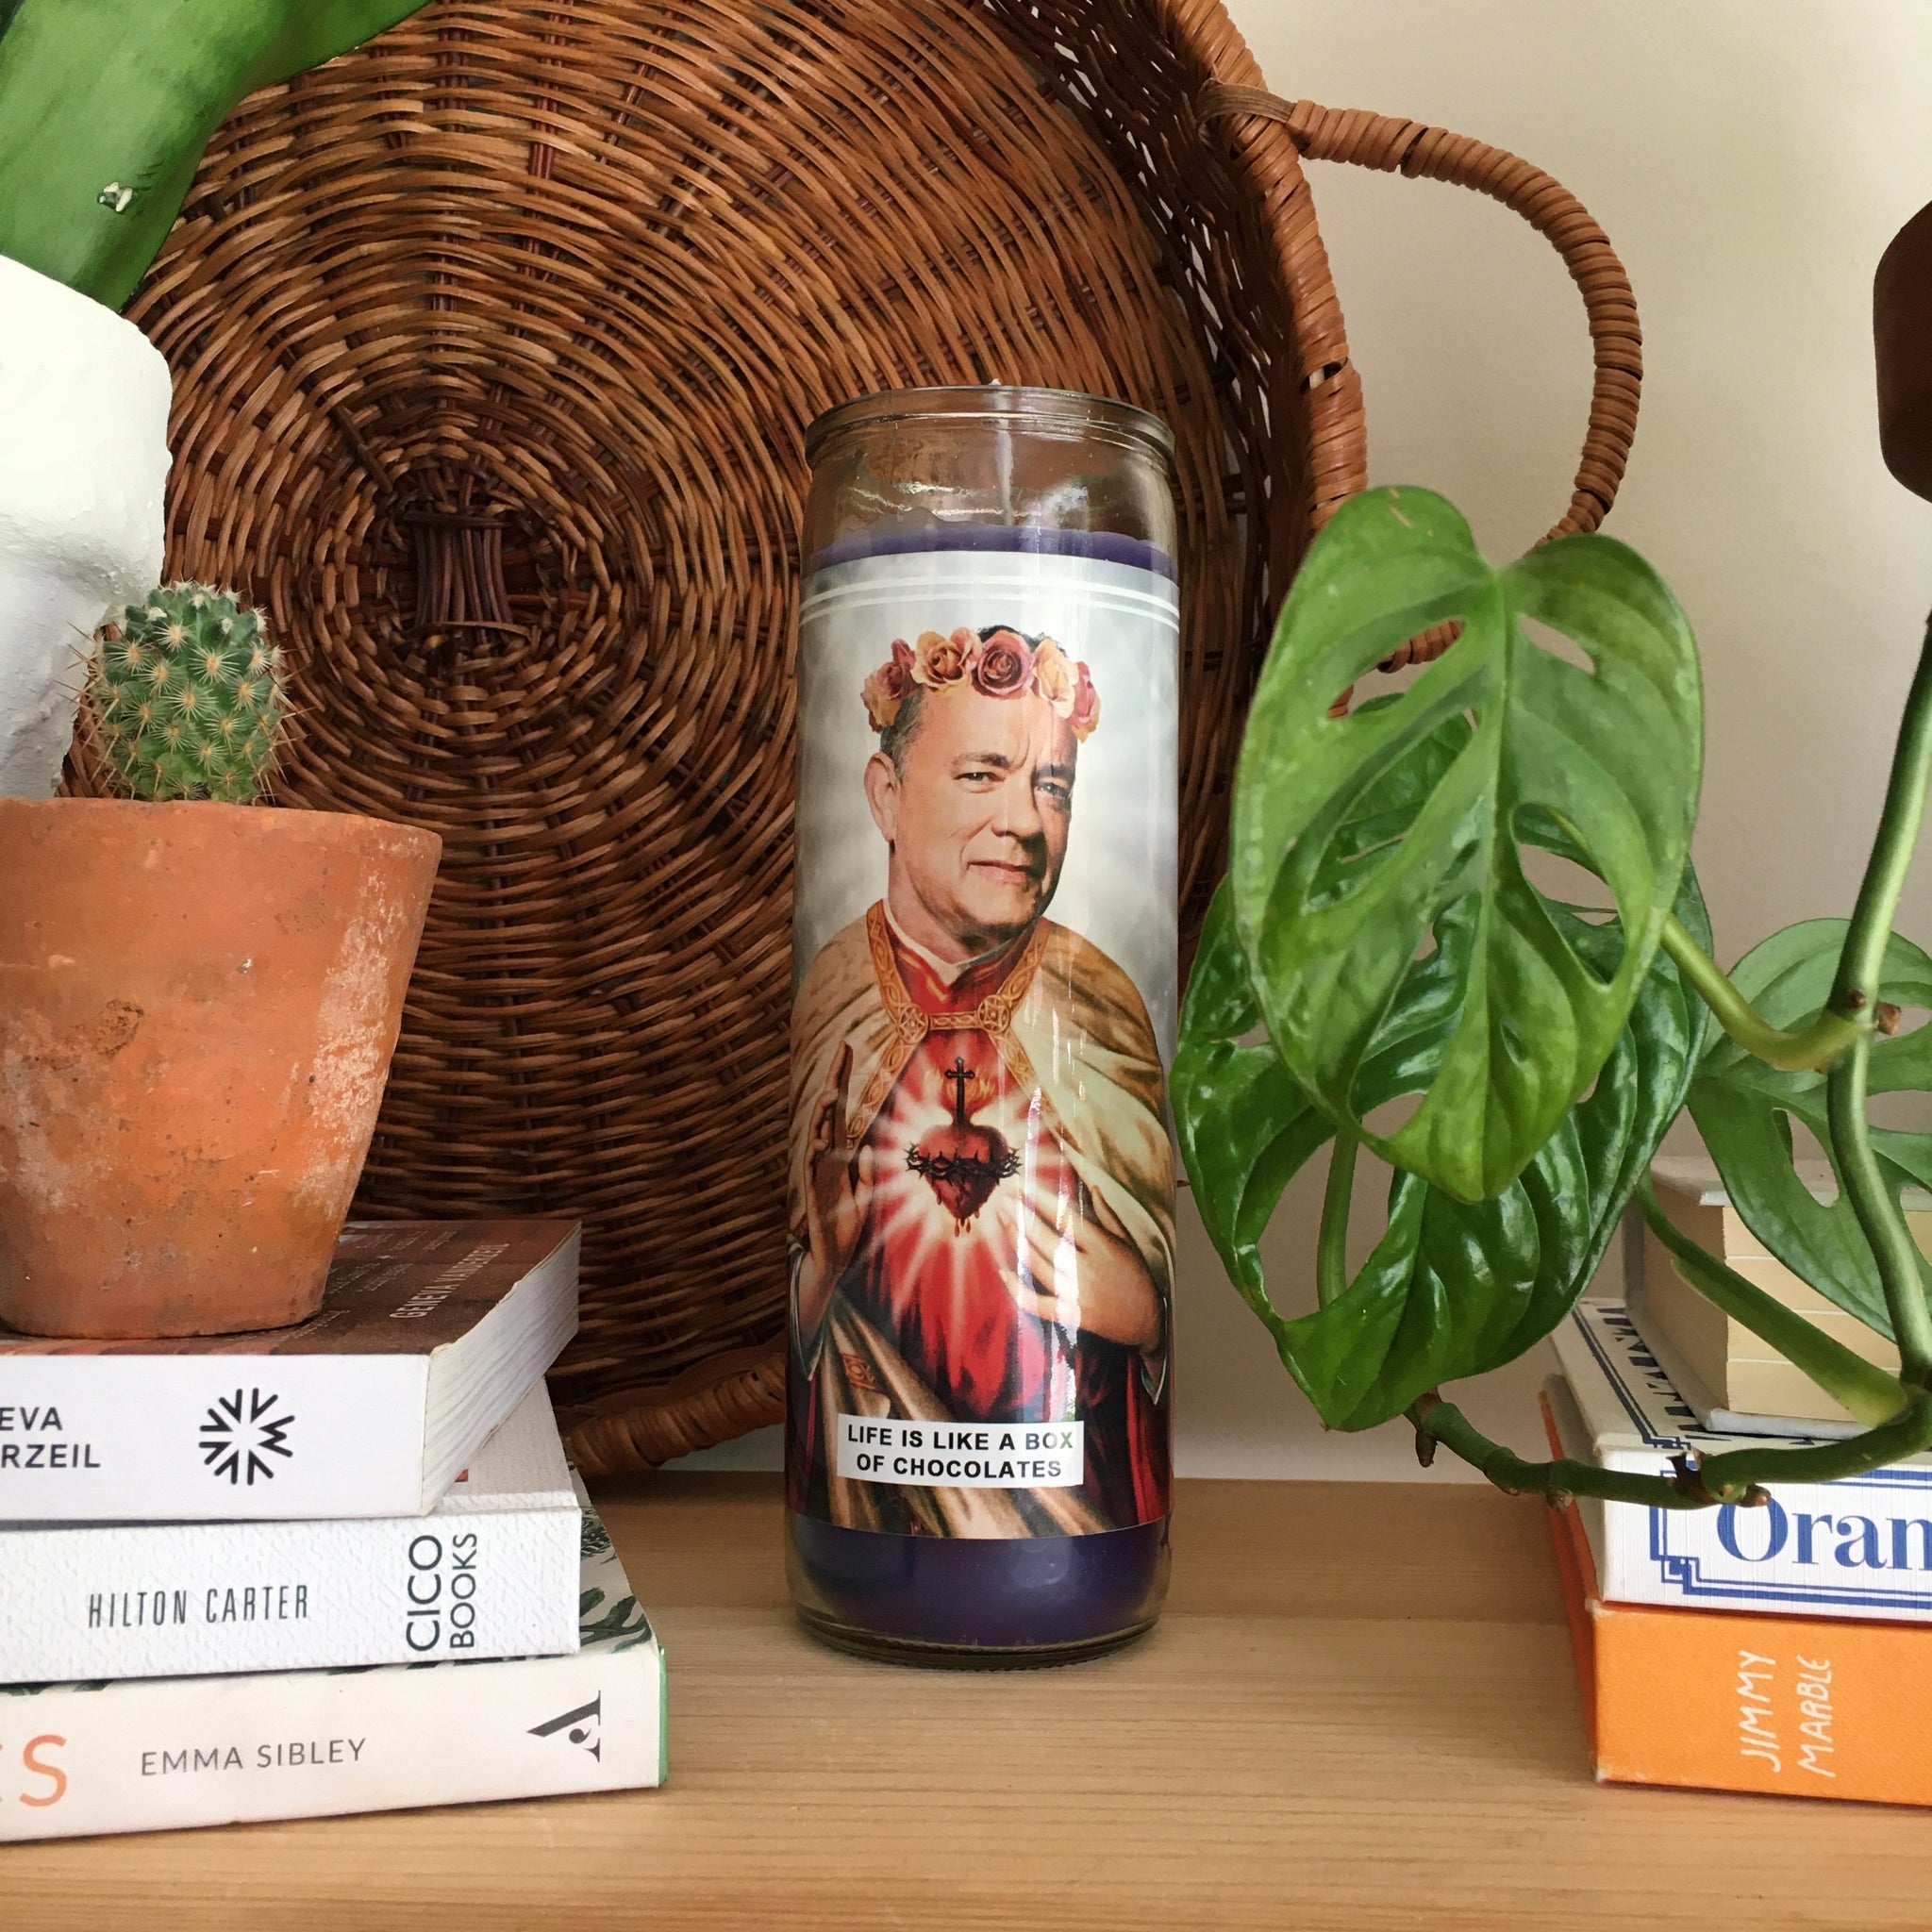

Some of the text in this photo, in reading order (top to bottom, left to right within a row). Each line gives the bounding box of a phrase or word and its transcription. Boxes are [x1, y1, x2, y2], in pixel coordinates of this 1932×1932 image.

[389, 1284, 460, 1319] GENEVA
[0, 1407, 63, 1431] EVA
[848, 1424, 1074, 1450] LIFE IS LIKE A BOX
[1, 1444, 101, 1468] RZEIL
[857, 1454, 1061, 1478] OF CHOCOLATES
[1717, 1495, 1932, 1571] Oran
[88, 1585, 308, 1628] HILTON CARTER
[406, 1535, 442, 1652] CICO
[450, 1533, 477, 1648] BOOKS
[1737, 1650, 1781, 1774] JIMMY
[1796, 1655, 1836, 1778] MARBLE
[0, 1734, 67, 1807] S
[141, 1738, 366, 1775] EMMA SIBLEY
